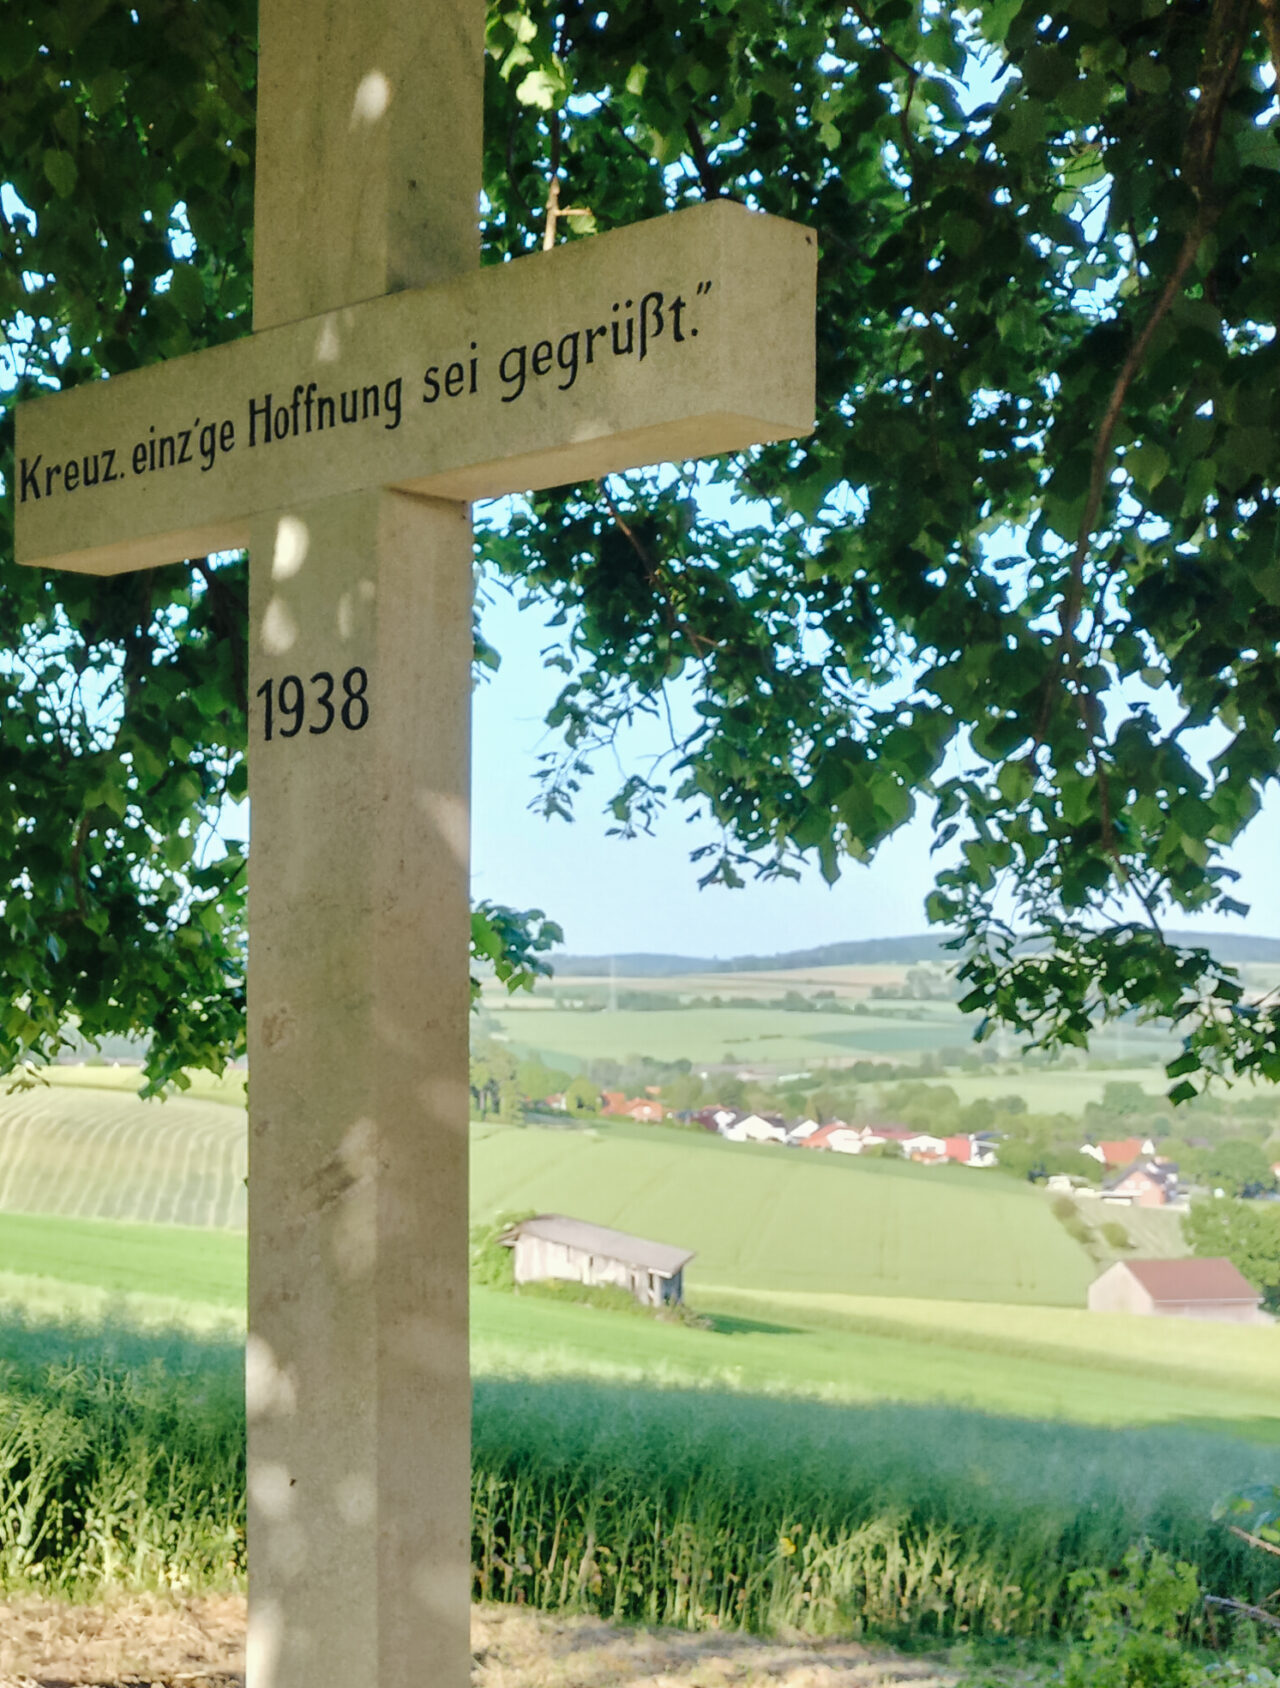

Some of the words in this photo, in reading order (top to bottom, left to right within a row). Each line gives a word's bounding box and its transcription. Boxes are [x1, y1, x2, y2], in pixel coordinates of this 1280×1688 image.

[248, 377, 402, 447] Hoffnung
[422, 341, 478, 403] sei
[256, 666, 369, 741] 1938
